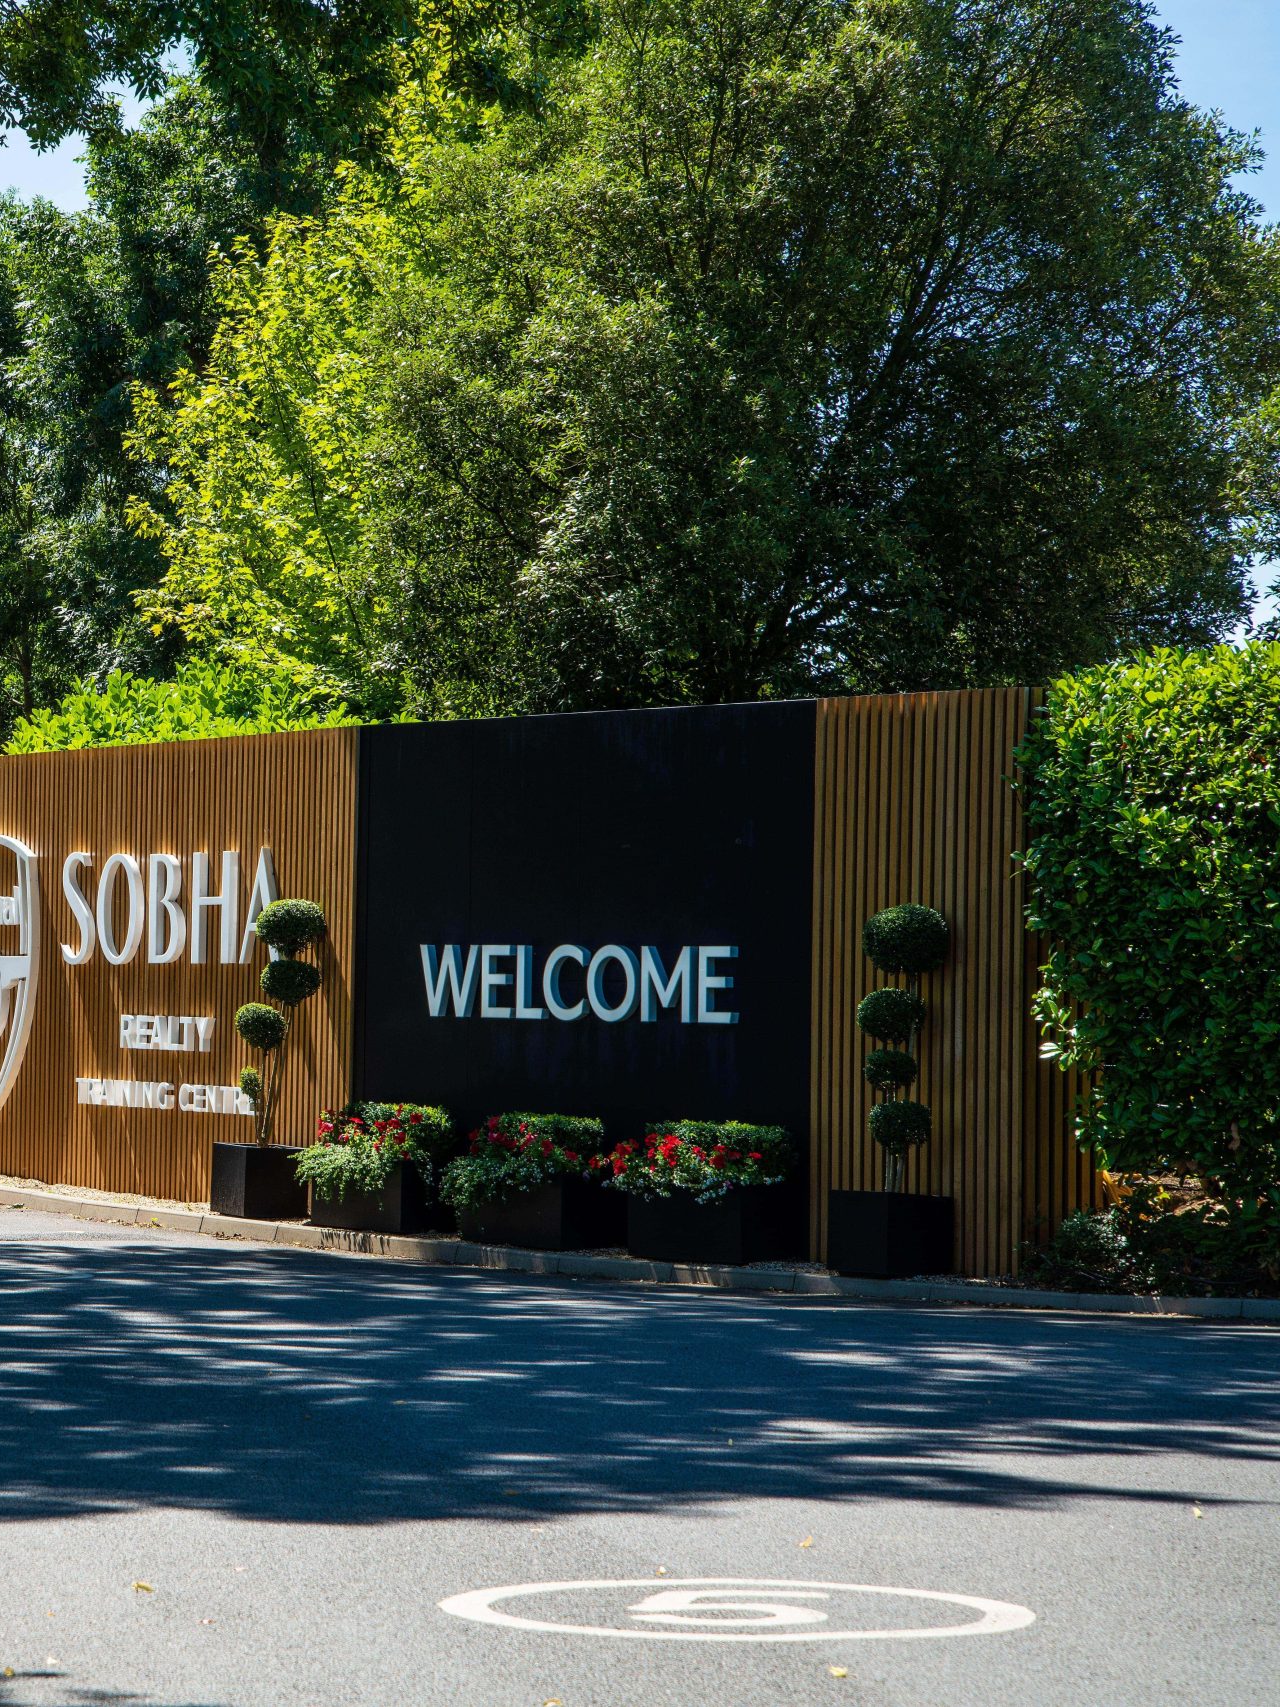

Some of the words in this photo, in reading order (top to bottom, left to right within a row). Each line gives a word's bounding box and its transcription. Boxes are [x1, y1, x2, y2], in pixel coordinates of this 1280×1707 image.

[60, 846, 279, 965] SOBHA
[420, 944, 739, 1024] WELCOME
[120, 1014, 216, 1052] REALTY
[76, 1078, 175, 1110] TRAINING
[627, 1590, 829, 1627] 5
